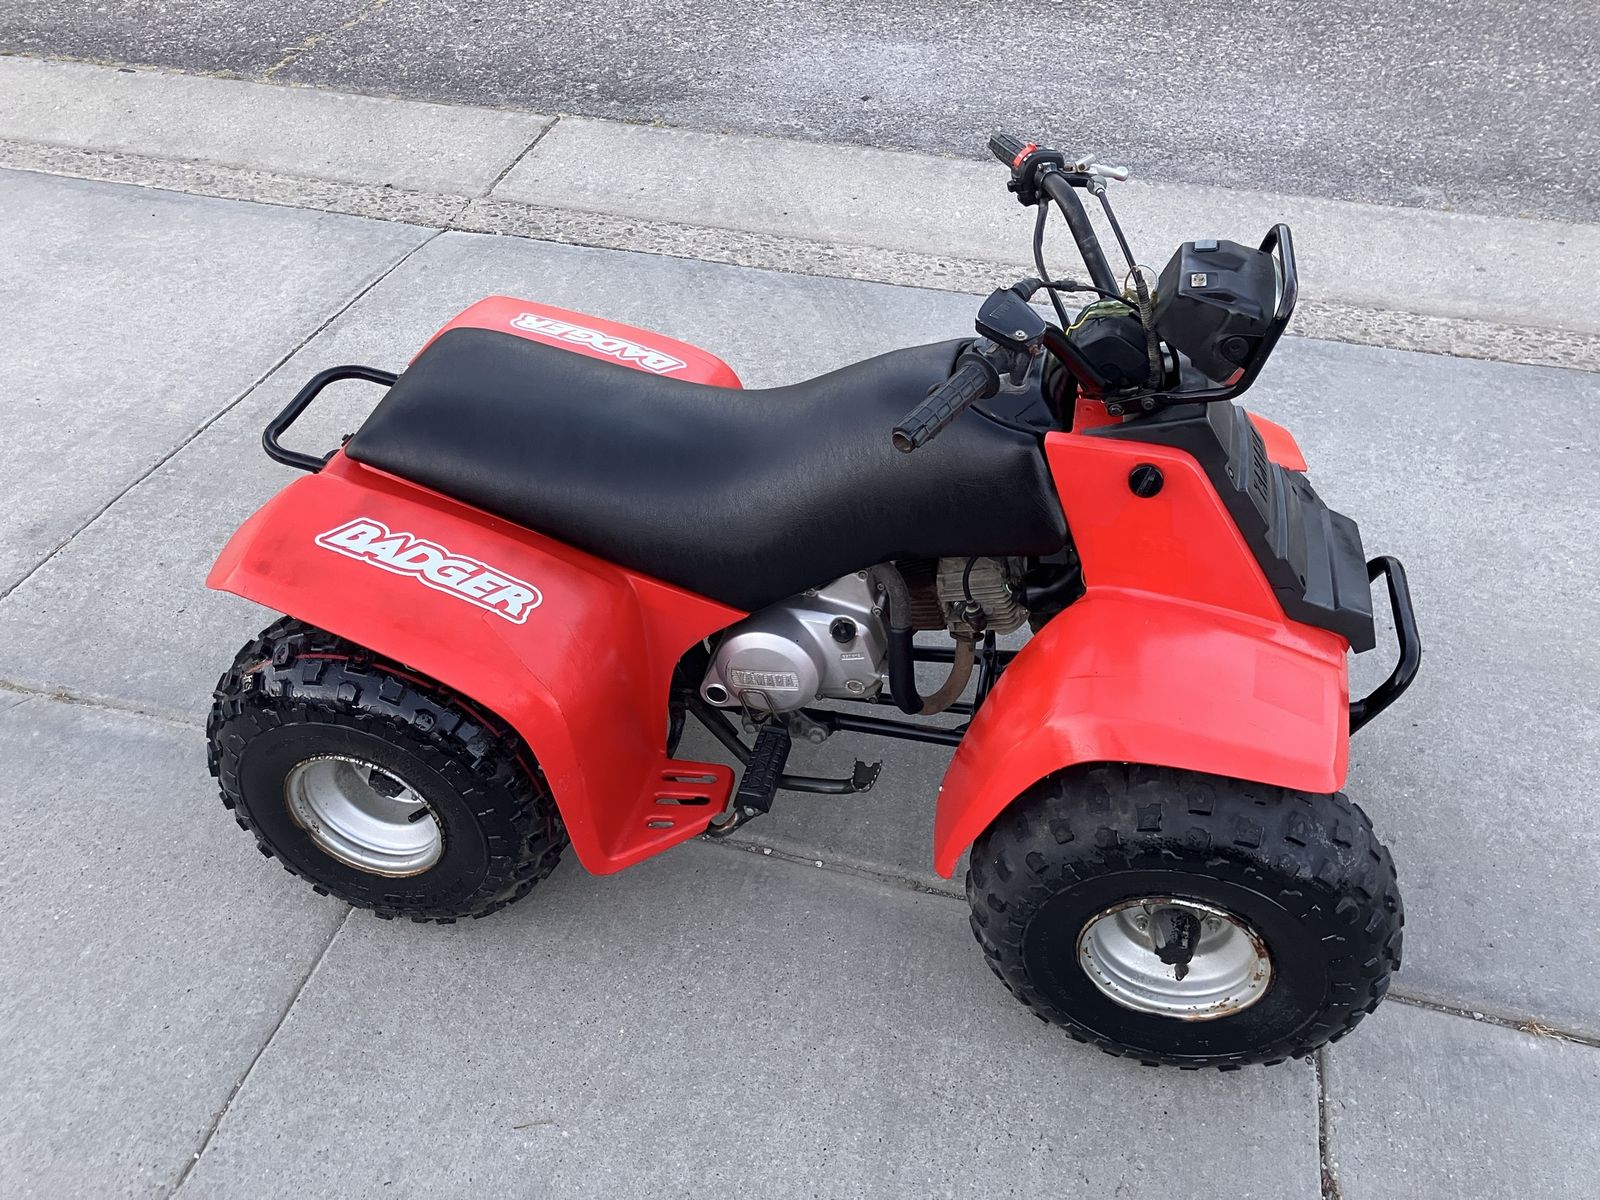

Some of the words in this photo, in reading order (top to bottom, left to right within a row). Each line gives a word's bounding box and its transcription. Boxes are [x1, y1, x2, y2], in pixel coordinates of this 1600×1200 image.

[512, 313, 685, 373] BADGER
[318, 518, 541, 622] BADGER
[735, 671, 795, 687] YAMAHA
